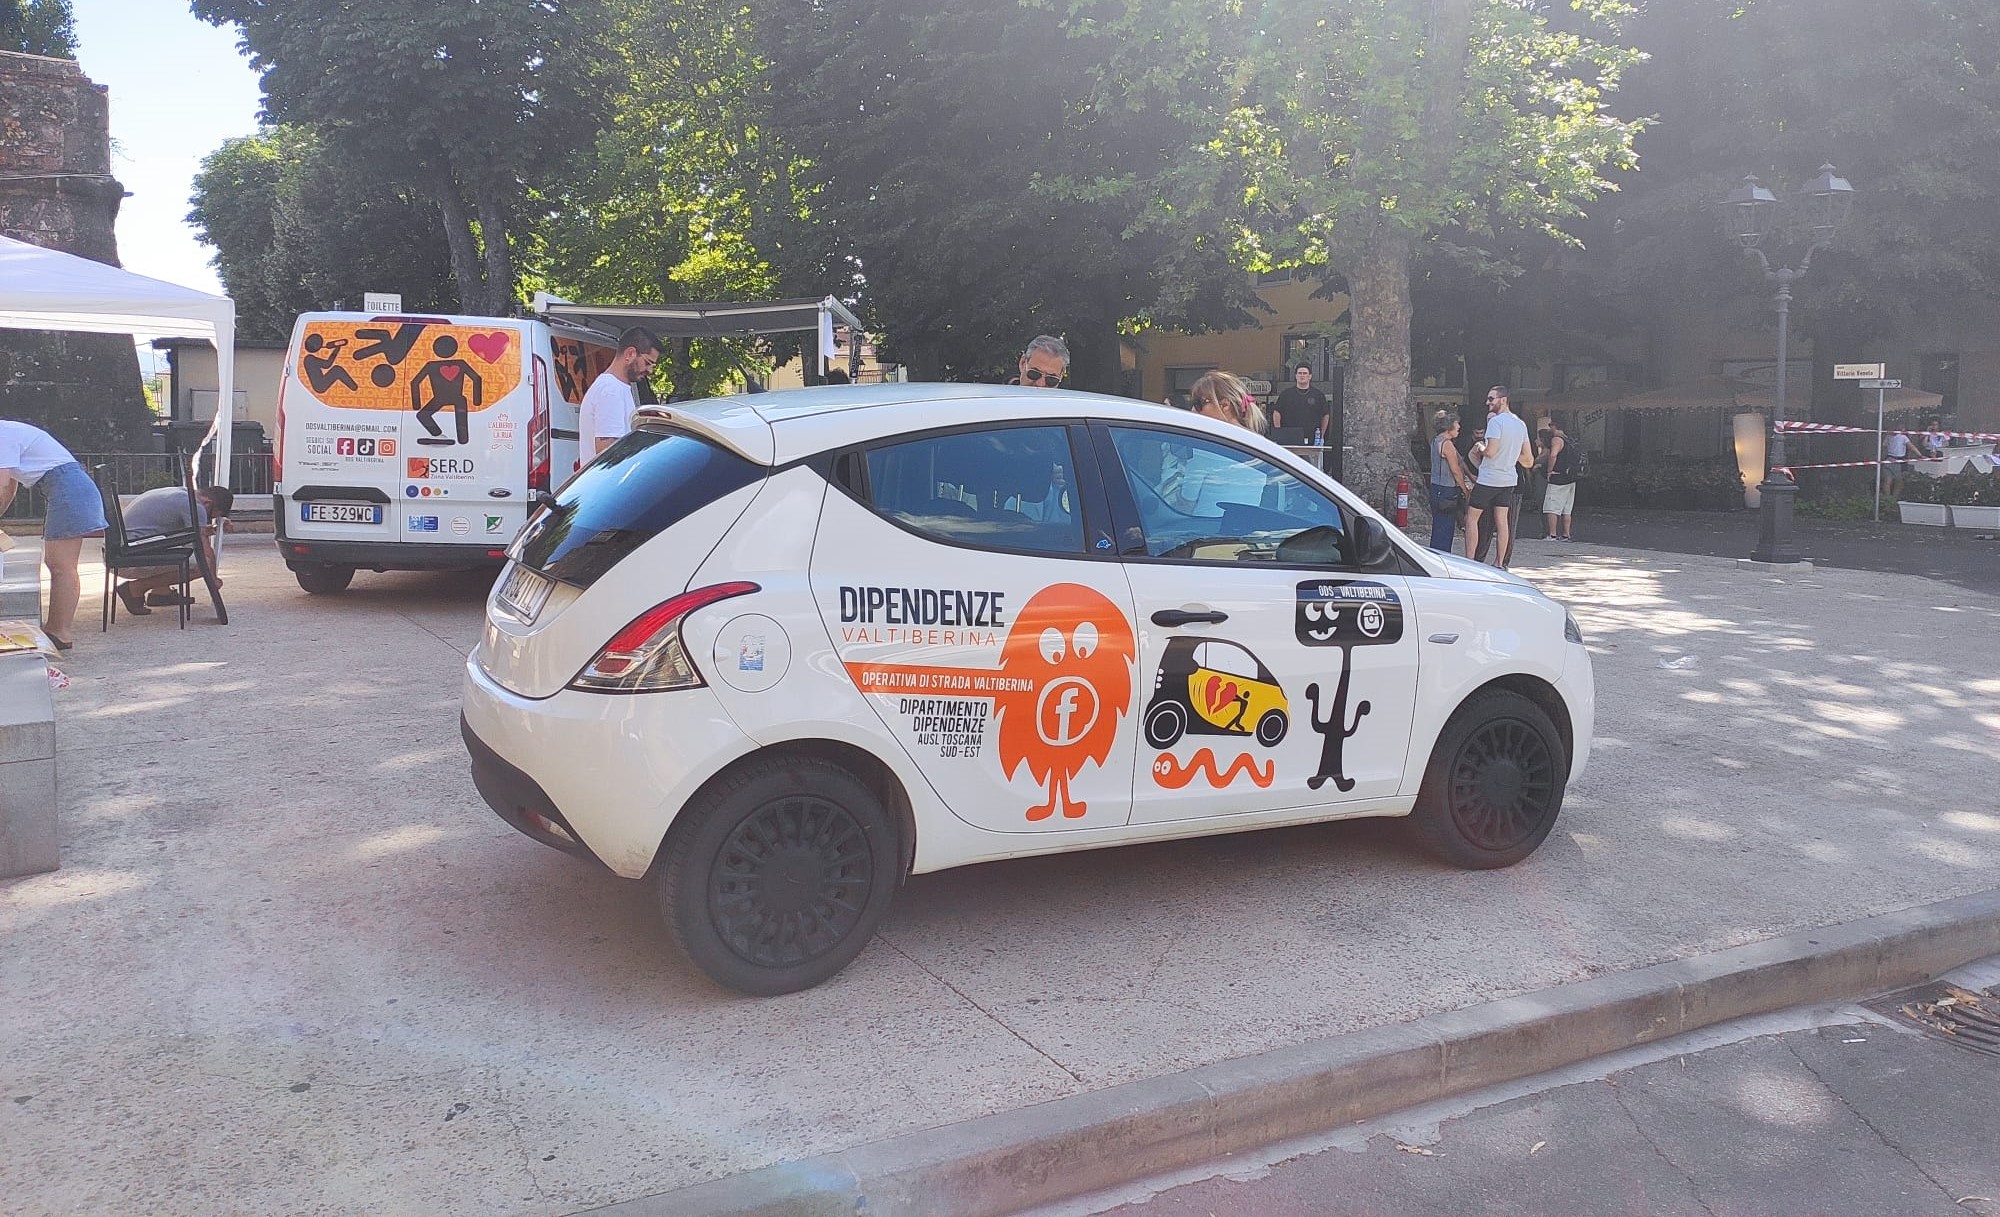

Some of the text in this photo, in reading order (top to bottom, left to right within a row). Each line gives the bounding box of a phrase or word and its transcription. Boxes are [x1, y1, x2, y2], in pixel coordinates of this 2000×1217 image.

[367, 301, 400, 312] TOILETTE
[308, 444, 332, 454] SOCIAL
[430, 458, 474, 474] SER.D
[839, 586, 1005, 628] DIPENDENZE
[842, 627, 996, 646] VALTIBERINA
[862, 671, 1034, 692] OPERATIVA DI STRADA VALTIBERINA
[900, 698, 988, 718] DIPARTIMENTO
[913, 716, 986, 734] DIPENDENZE
[917, 734, 982, 746] AUSL TOSCANA
[940, 746, 980, 758] SUD-EST
